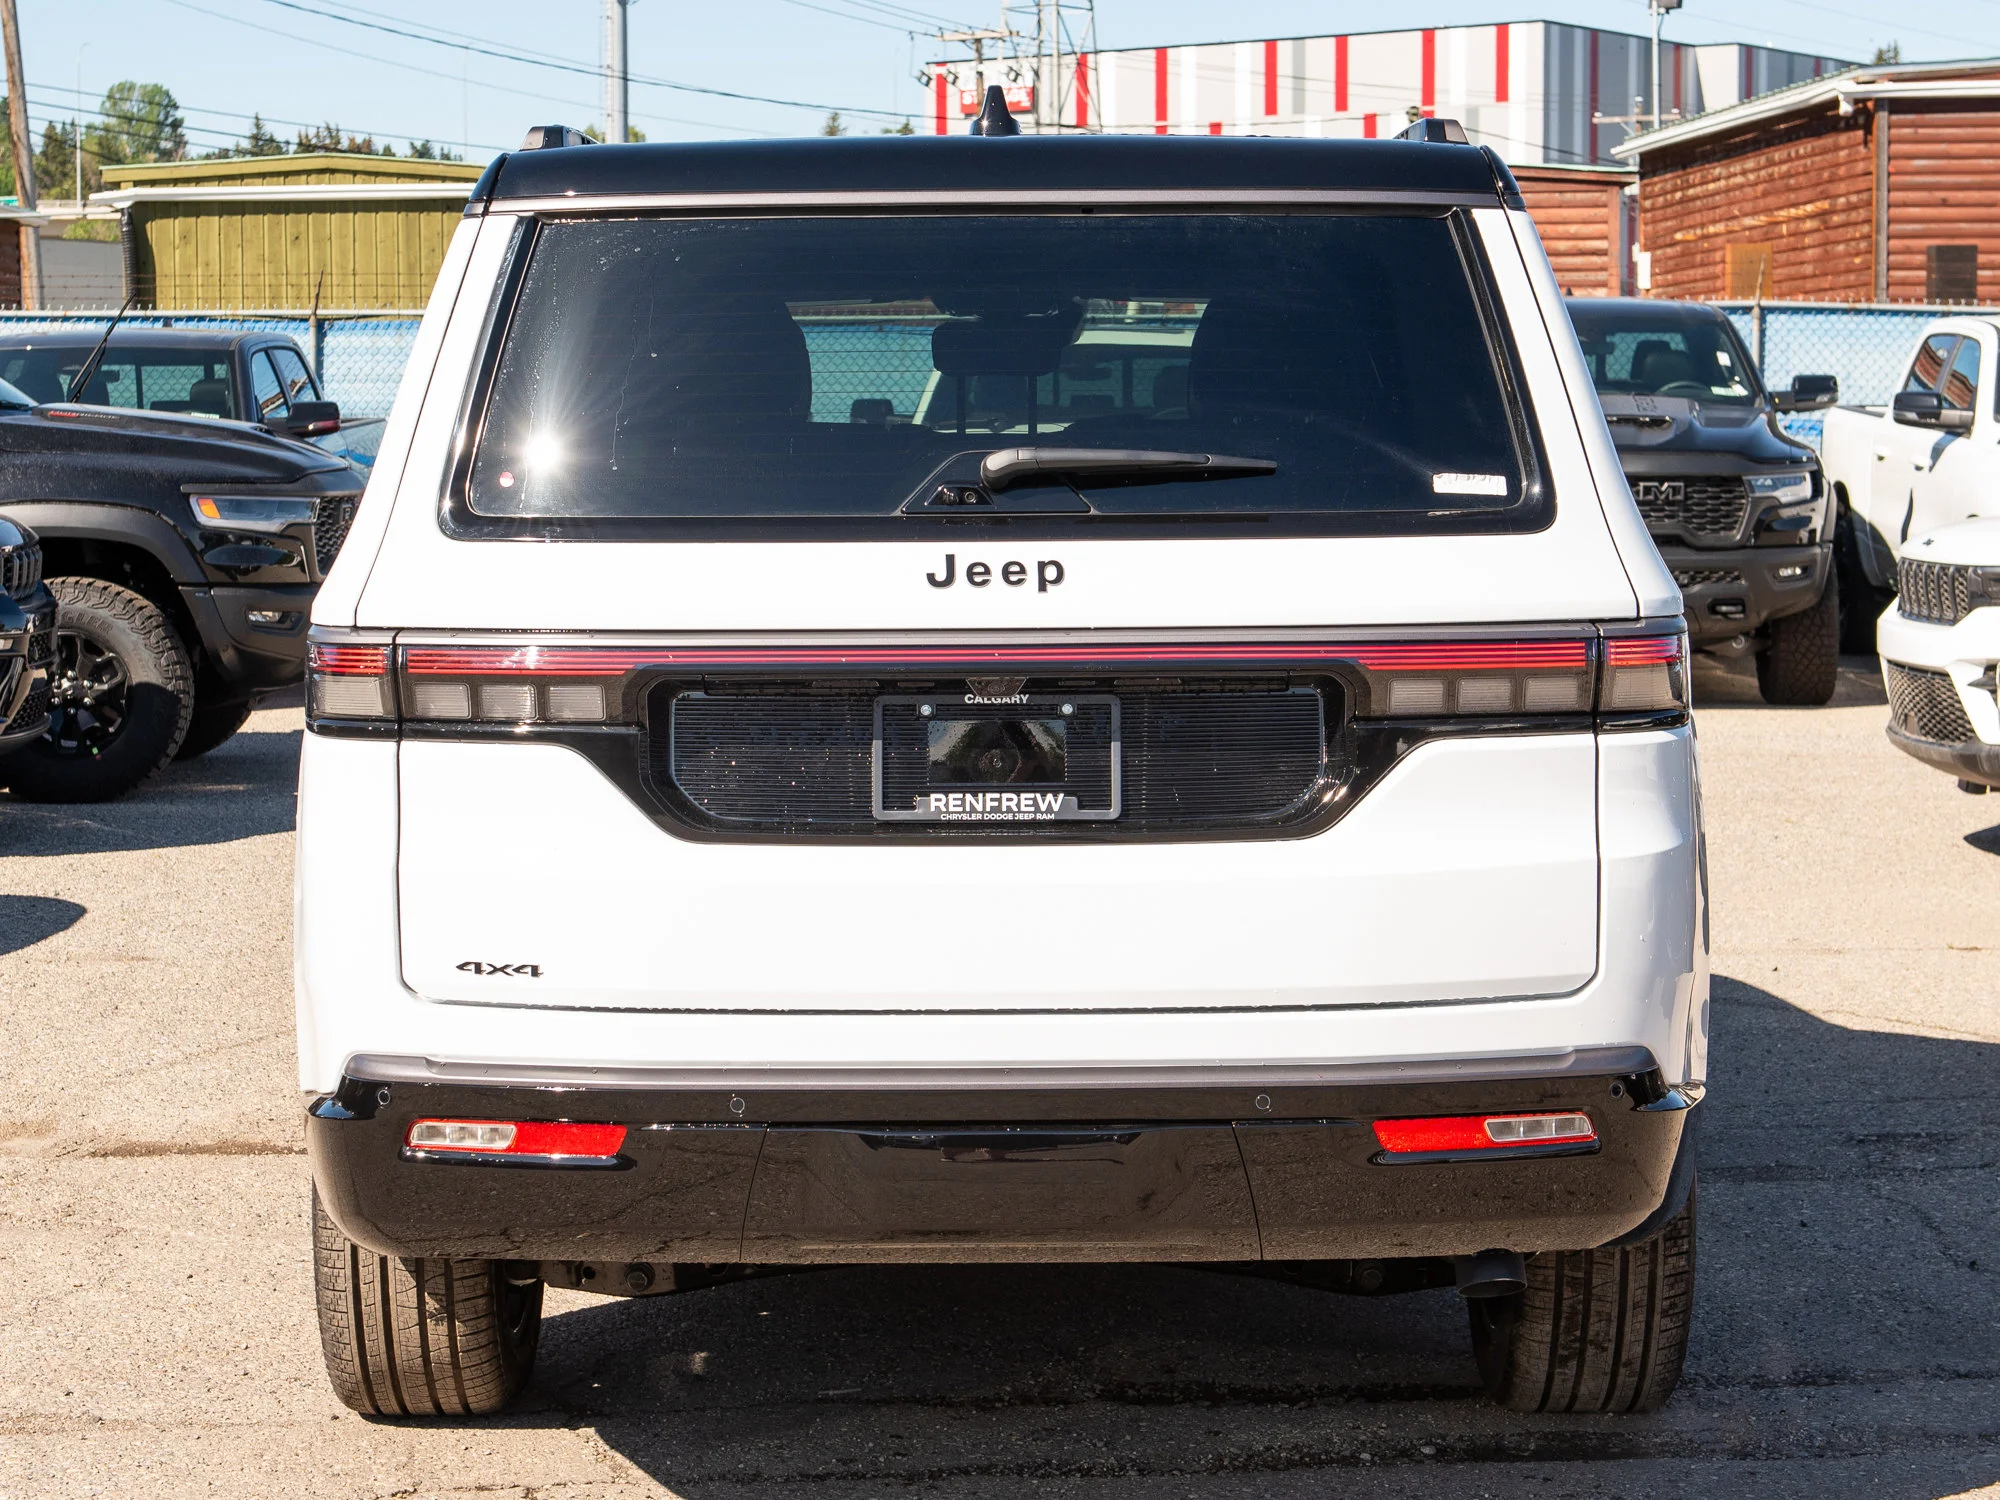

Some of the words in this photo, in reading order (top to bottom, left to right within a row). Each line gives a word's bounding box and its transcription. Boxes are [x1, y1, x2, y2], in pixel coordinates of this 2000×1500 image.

[926, 553, 1065, 593] Jeep
[964, 693, 1030, 704] CALGARY
[929, 792, 1065, 812] RENFREW
